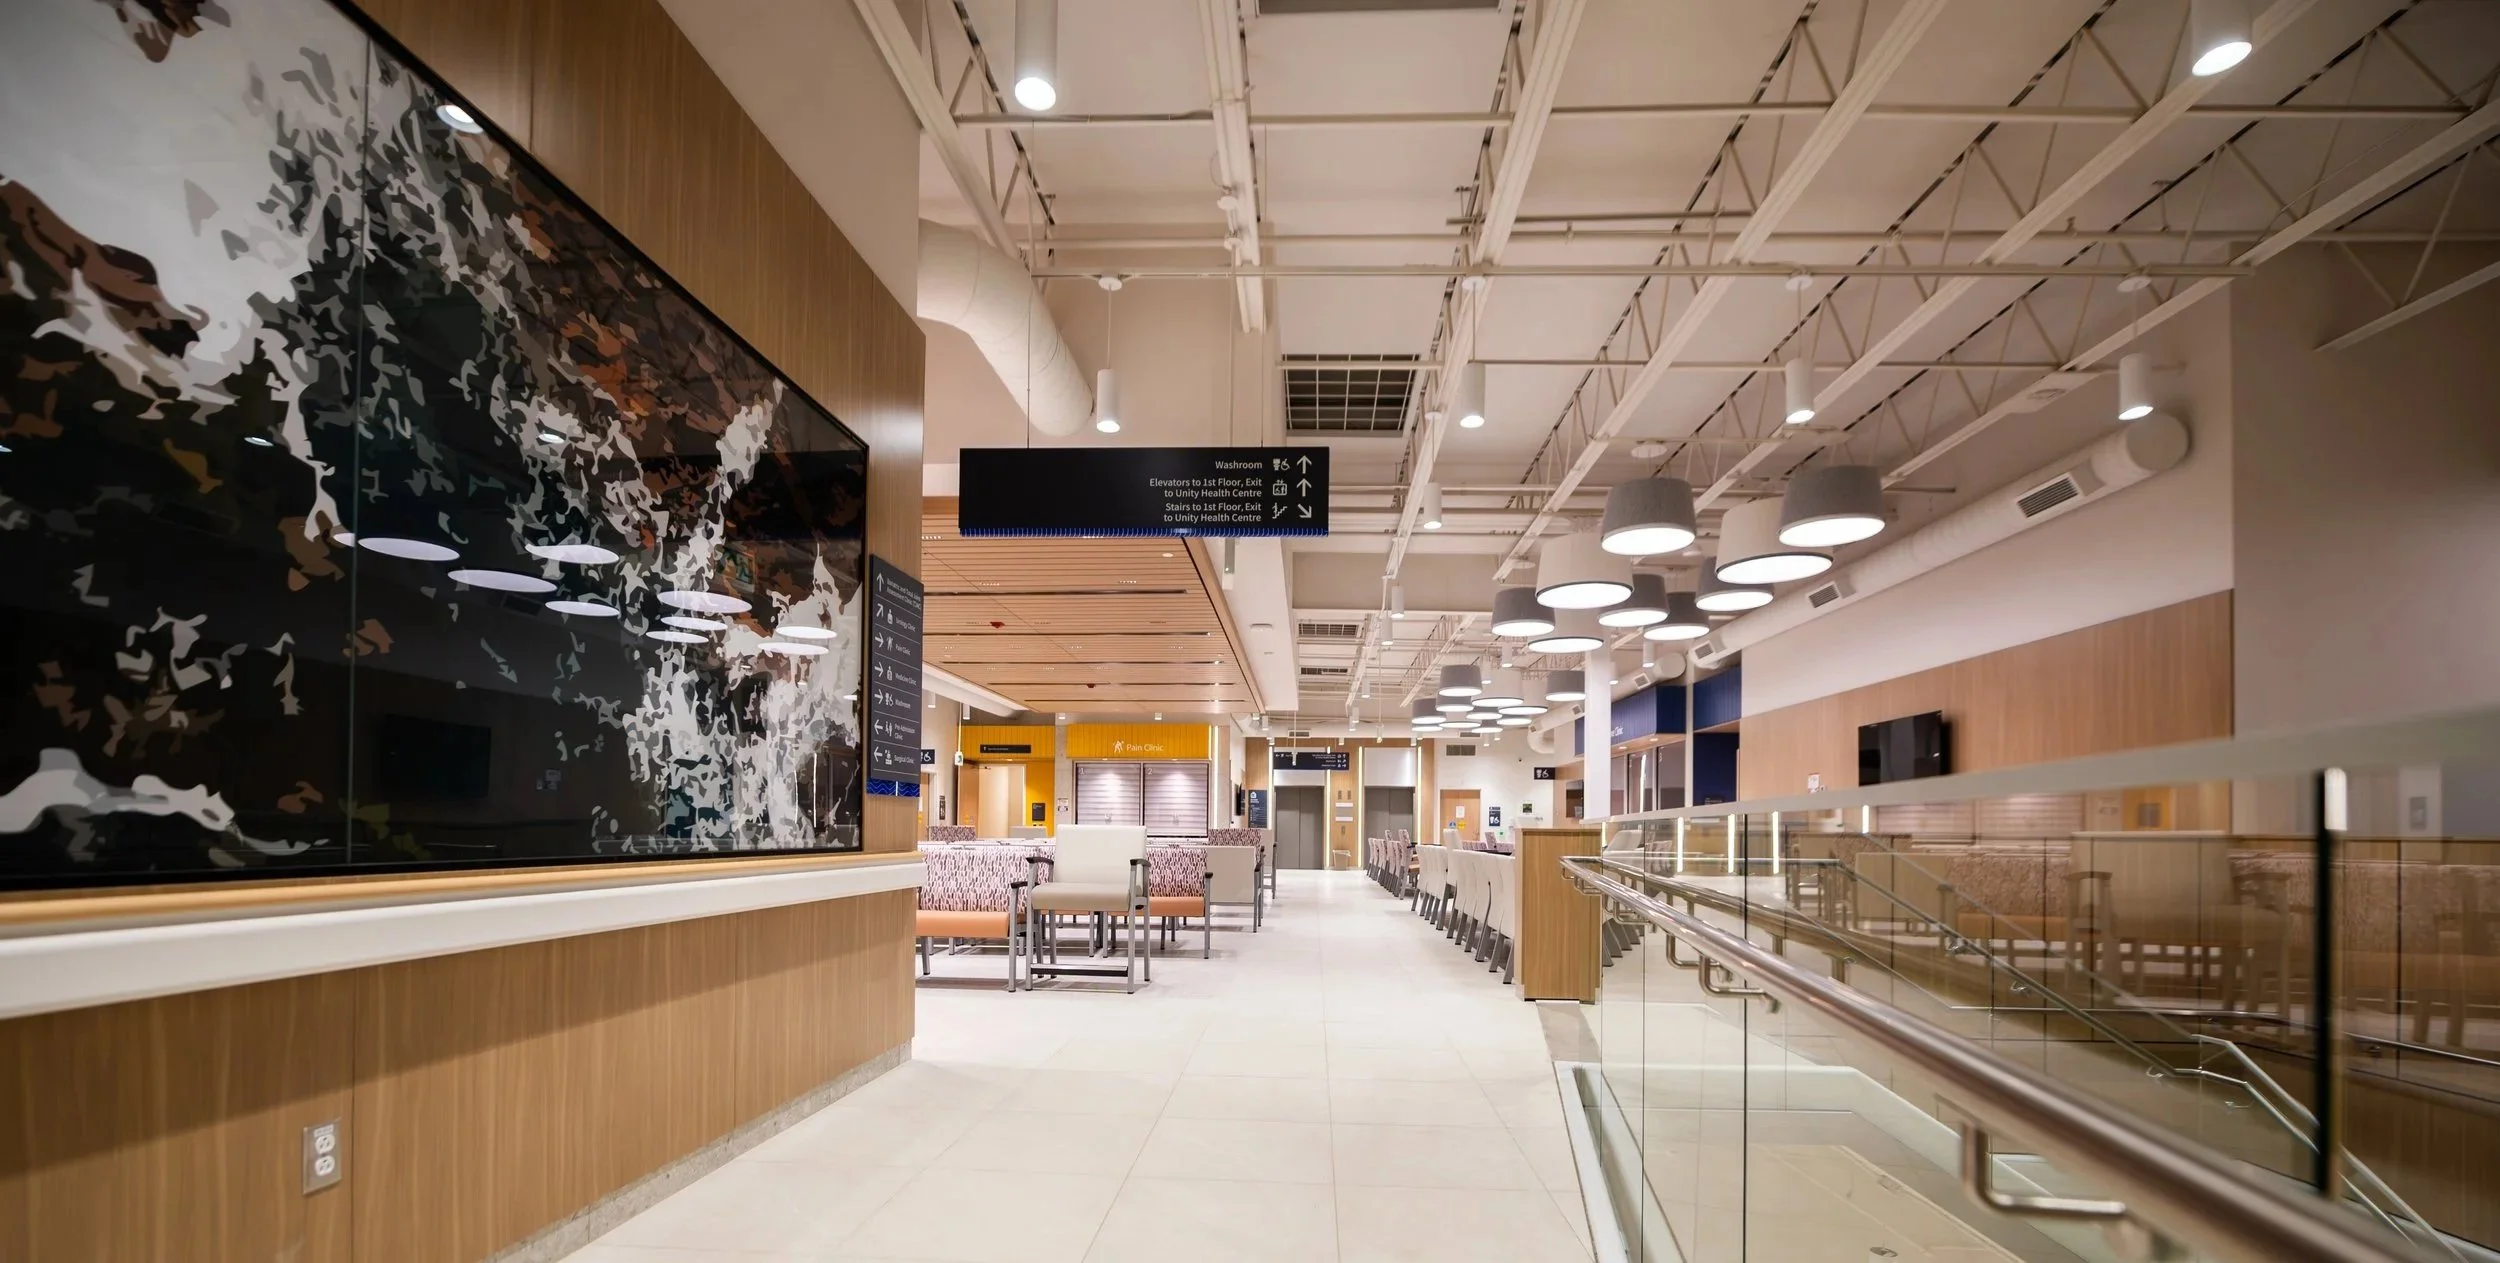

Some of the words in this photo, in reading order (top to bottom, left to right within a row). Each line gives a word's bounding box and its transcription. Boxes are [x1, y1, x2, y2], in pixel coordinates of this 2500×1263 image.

[1215, 460, 1263, 469] Washroom
[1150, 478, 1190, 487] Elevators
[1192, 479, 1201, 487] to
[1203, 478, 1215, 487] 1st
[1218, 478, 1243, 489] Floor,
[1245, 478, 1262, 487] Exit
[1164, 489, 1174, 498] to
[1176, 489, 1199, 500] Unity
[1201, 488, 1230, 498] Health
[1232, 489, 1262, 498] Centre
[1166, 502, 1190, 511] Stairs
[1192, 503, 1201, 511] to
[1203, 502, 1216, 511] 1st
[1218, 502, 1244, 513] Floor,
[1245, 502, 1262, 511] Exit
[1164, 514, 1173, 522] to
[1175, 513, 1198, 524] Unity
[1201, 513, 1229, 522] Health
[1231, 513, 1261, 522] Centre
[902, 647, 911, 656] Clinic
